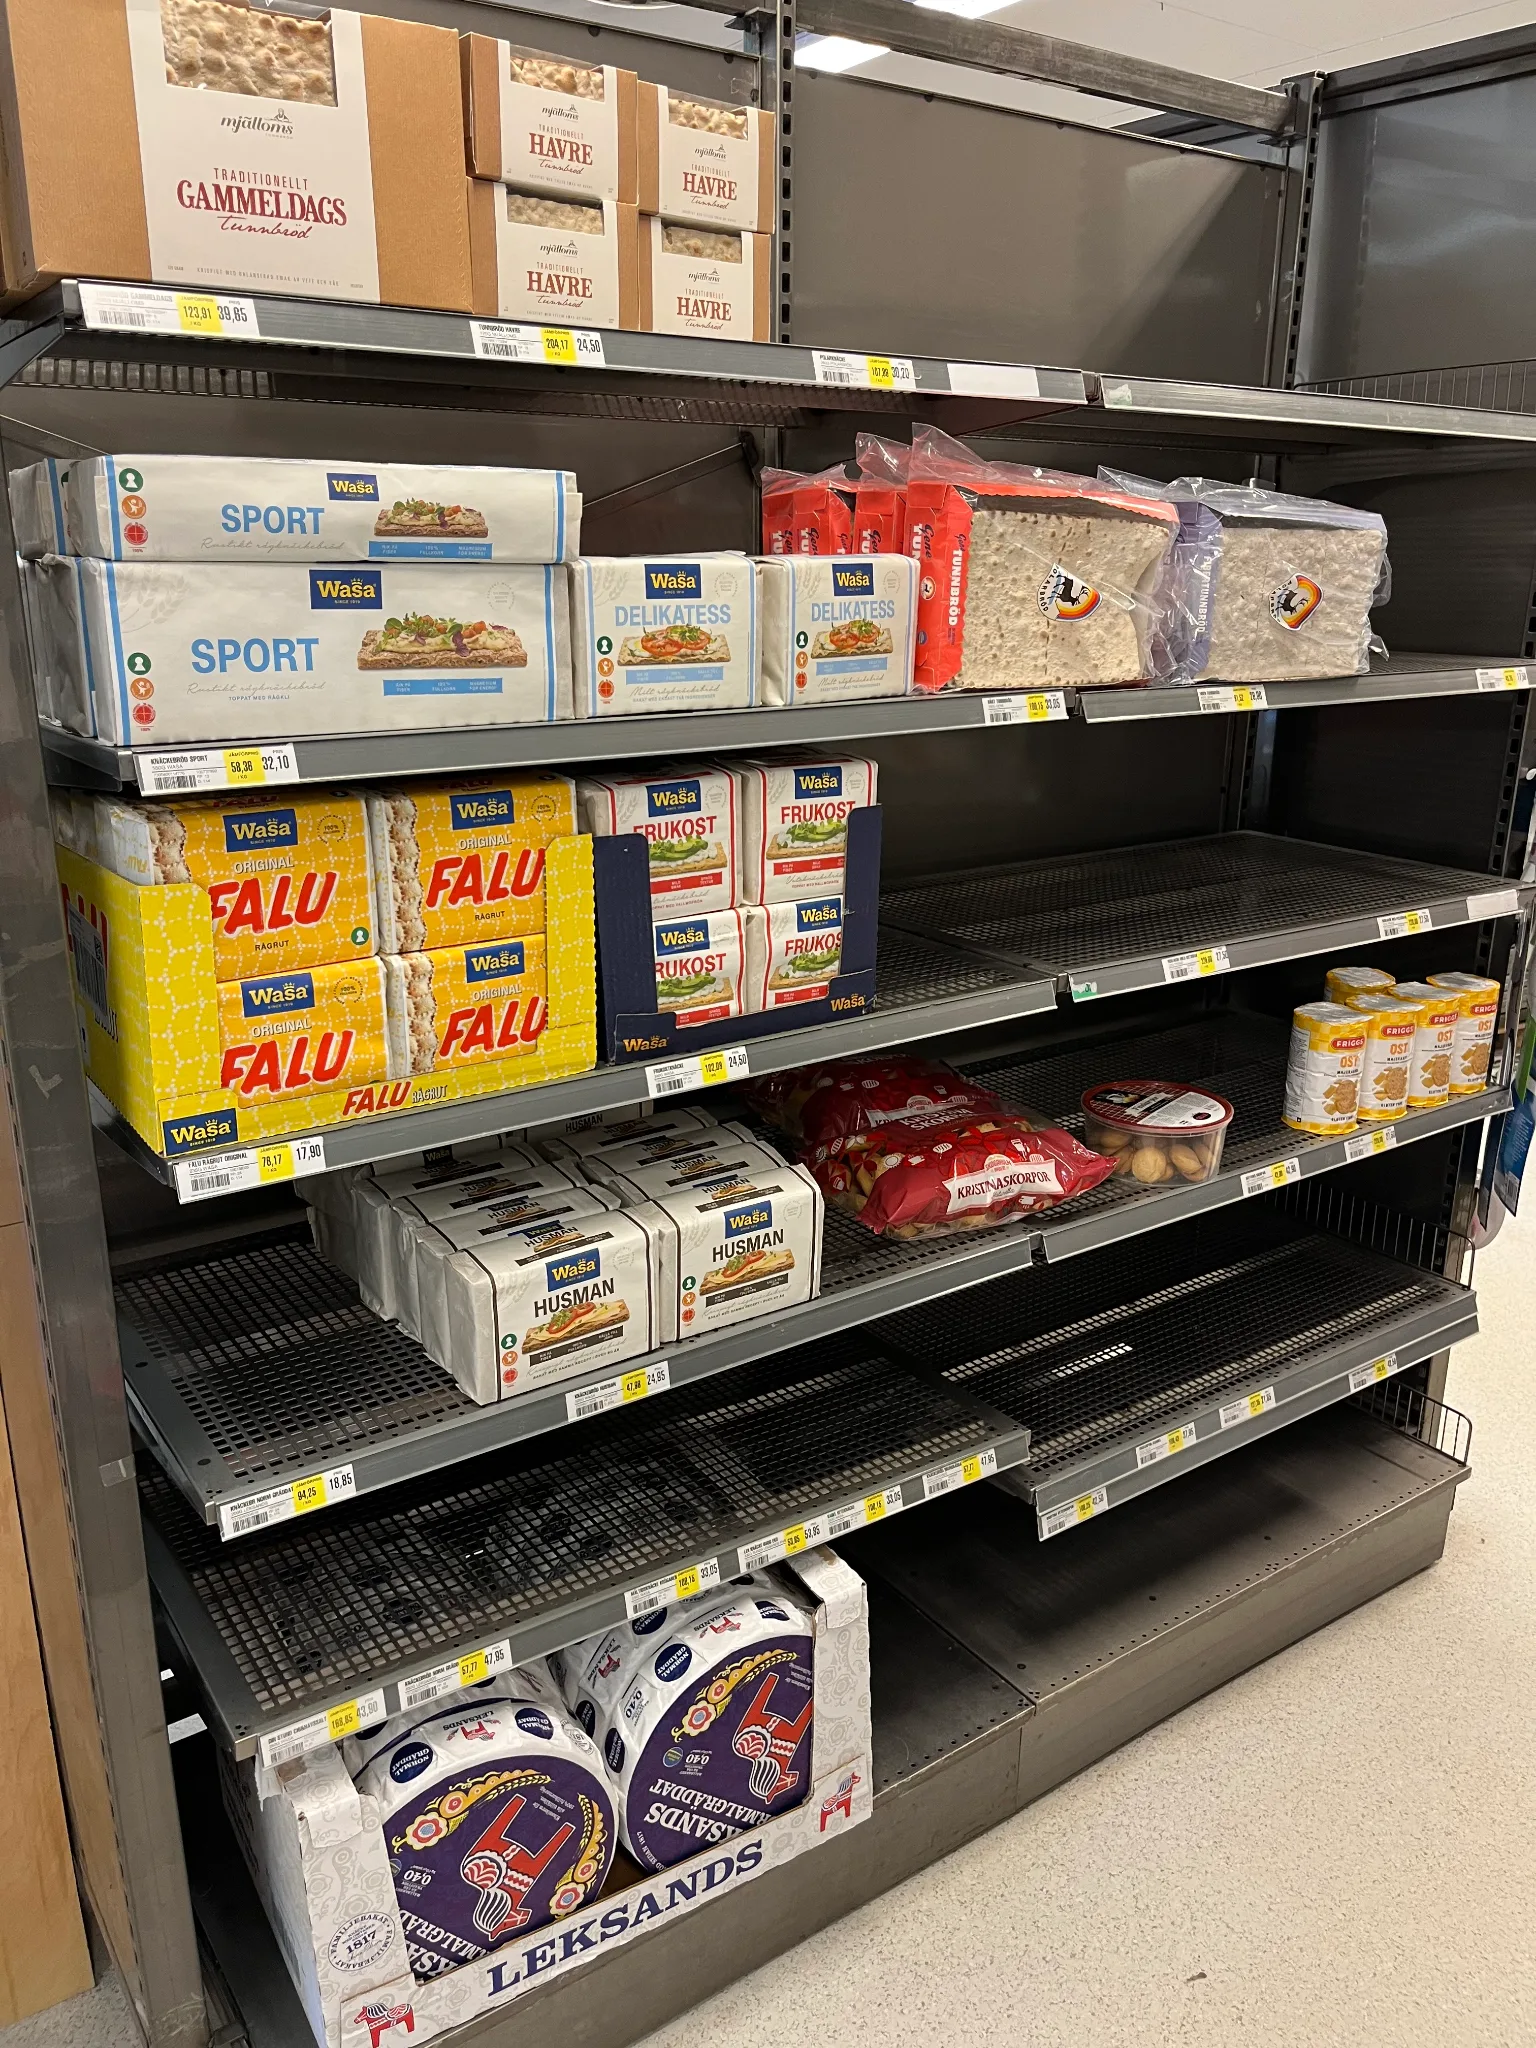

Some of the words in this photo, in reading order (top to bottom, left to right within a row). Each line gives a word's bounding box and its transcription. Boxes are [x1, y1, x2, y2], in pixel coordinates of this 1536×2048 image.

[539, 124, 584, 140] TRADITIONELLT
[529, 132, 592, 166] HAVRE
[213, 167, 308, 190] TRADITIONELLT
[682, 172, 737, 200] HAVRE
[177, 180, 347, 226] GAMMELDAGS
[536, 262, 584, 275] TRADITIONELLT
[526, 270, 592, 298] HAVRE
[184, 305, 212, 320] 123,91
[217, 305, 248, 322] 39,65
[676, 296, 732, 321] HAVRE
[546, 338, 568, 350] 204,17
[576, 338, 600, 352] 24,50
[332, 479, 374, 494] Wasa
[221, 504, 324, 535] SPORT
[201, 538, 252, 550] Rustikt
[257, 539, 345, 555] rågknäckebröd
[317, 579, 375, 598] Wasa
[650, 574, 696, 588] Wasa
[836, 572, 870, 587] Wasa
[948, 549, 962, 626] TUNNBRÖD
[615, 604, 731, 626] DELIKATESS
[812, 600, 895, 622] DELIKATESS
[191, 638, 320, 674] SPORT
[186, 683, 236, 694] Rustikt
[240, 682, 326, 698] rågknäckebröd
[151, 756, 188, 764] KNÄCKEBRÖD
[231, 761, 252, 773] 58,36
[262, 755, 290, 772] 32,10
[800, 776, 838, 790] Wasa
[457, 799, 508, 819] Wasa
[653, 792, 697, 808] Wasa
[781, 801, 856, 824] FRUKOST
[232, 819, 290, 840] Wasa
[633, 815, 718, 842] FRUKOST
[458, 834, 512, 850] ORIGINAL
[234, 856, 294, 874] ORIGINAL
[426, 847, 546, 908] FALU
[208, 870, 338, 934] FALU
[474, 910, 506, 921] RÅGRUT
[801, 909, 838, 924] Wasa
[254, 940, 290, 951] RÅGRUT
[661, 932, 704, 948] Wasa
[471, 952, 520, 970] Wasa
[249, 987, 308, 1006] Wasa
[472, 982, 522, 1000] ORIGINAL
[831, 996, 866, 1012] Wasa
[438, 996, 548, 1057] FALU
[1434, 1013, 1458, 1023] FRIGGS
[1478, 1020, 1492, 1032] OST
[252, 1018, 312, 1038] ORIGINAL
[1386, 1025, 1414, 1035] FRIGGS
[1437, 1030, 1452, 1042] OST
[624, 1038, 668, 1052] Wasa
[1336, 1038, 1364, 1048] FRIGGS
[1390, 1042, 1408, 1055] OST
[221, 1030, 354, 1095] FALU
[729, 1054, 747, 1068] 24,50
[1340, 1055, 1359, 1068] OST
[342, 1080, 412, 1116] FALU
[412, 1084, 448, 1104] RÅGRUT
[566, 1114, 603, 1132] HUSMAN
[170, 1121, 232, 1145] Wasa
[188, 1160, 202, 1168] FALU
[202, 1157, 222, 1166] RÅGRUT
[224, 1152, 248, 1162] ORIGINAL
[262, 1154, 282, 1168] 78,17
[296, 1144, 321, 1160] 17,90
[671, 1155, 717, 1170] HUSMAN
[702, 1178, 750, 1194] HUSMAN
[957, 1171, 1050, 1200] KRISTINASKORPOR
[488, 1201, 540, 1219] HUSMAN
[730, 1212, 768, 1229] Wasa
[524, 1226, 578, 1248] HUSMAN
[713, 1228, 784, 1262] HUSMAN
[552, 1261, 596, 1282] Wasa
[534, 1278, 615, 1318] HUSMAN
[647, 1370, 666, 1386] 24,95
[297, 1487, 317, 1500] 94,25
[329, 1474, 352, 1490] 18,85
[230, 1498, 256, 1512] KNÄCKEBR
[256, 1494, 271, 1504] NORM
[272, 1486, 294, 1499] GRÄDDAT
[886, 1490, 901, 1504] 33,05
[804, 1524, 820, 1540] 53,95
[700, 1563, 718, 1578] 33,05
[694, 1606, 737, 1632] LEKSANDS
[461, 1662, 478, 1675] 57,77
[484, 1649, 504, 1666] 47,95
[588, 1637, 616, 1682] LEKSANDS
[656, 1646, 687, 1674] GRÄDDAT
[662, 1651, 690, 1678] NORMAL
[405, 1675, 432, 1686] KNÄCKEBRÖD
[432, 1668, 445, 1678] NORM
[331, 1712, 354, 1730] 168,85
[356, 1701, 378, 1718] 43,90
[443, 1710, 494, 1730] LEKSANDS
[392, 1747, 430, 1772] GRÄDDAT
[396, 1754, 430, 1776] NORMAL
[685, 1754, 710, 1766] 0,40
[636, 1831, 646, 1846] 1817
[642, 1846, 656, 1865] SEDAN
[404, 1870, 432, 1886] 0,40
[487, 1839, 763, 1998] LEKSANDS
[331, 1914, 389, 1955] FAMILJEBAKAT
[346, 1930, 378, 1955] 1817
[334, 1929, 394, 1970] FAMILJEBAKAT
